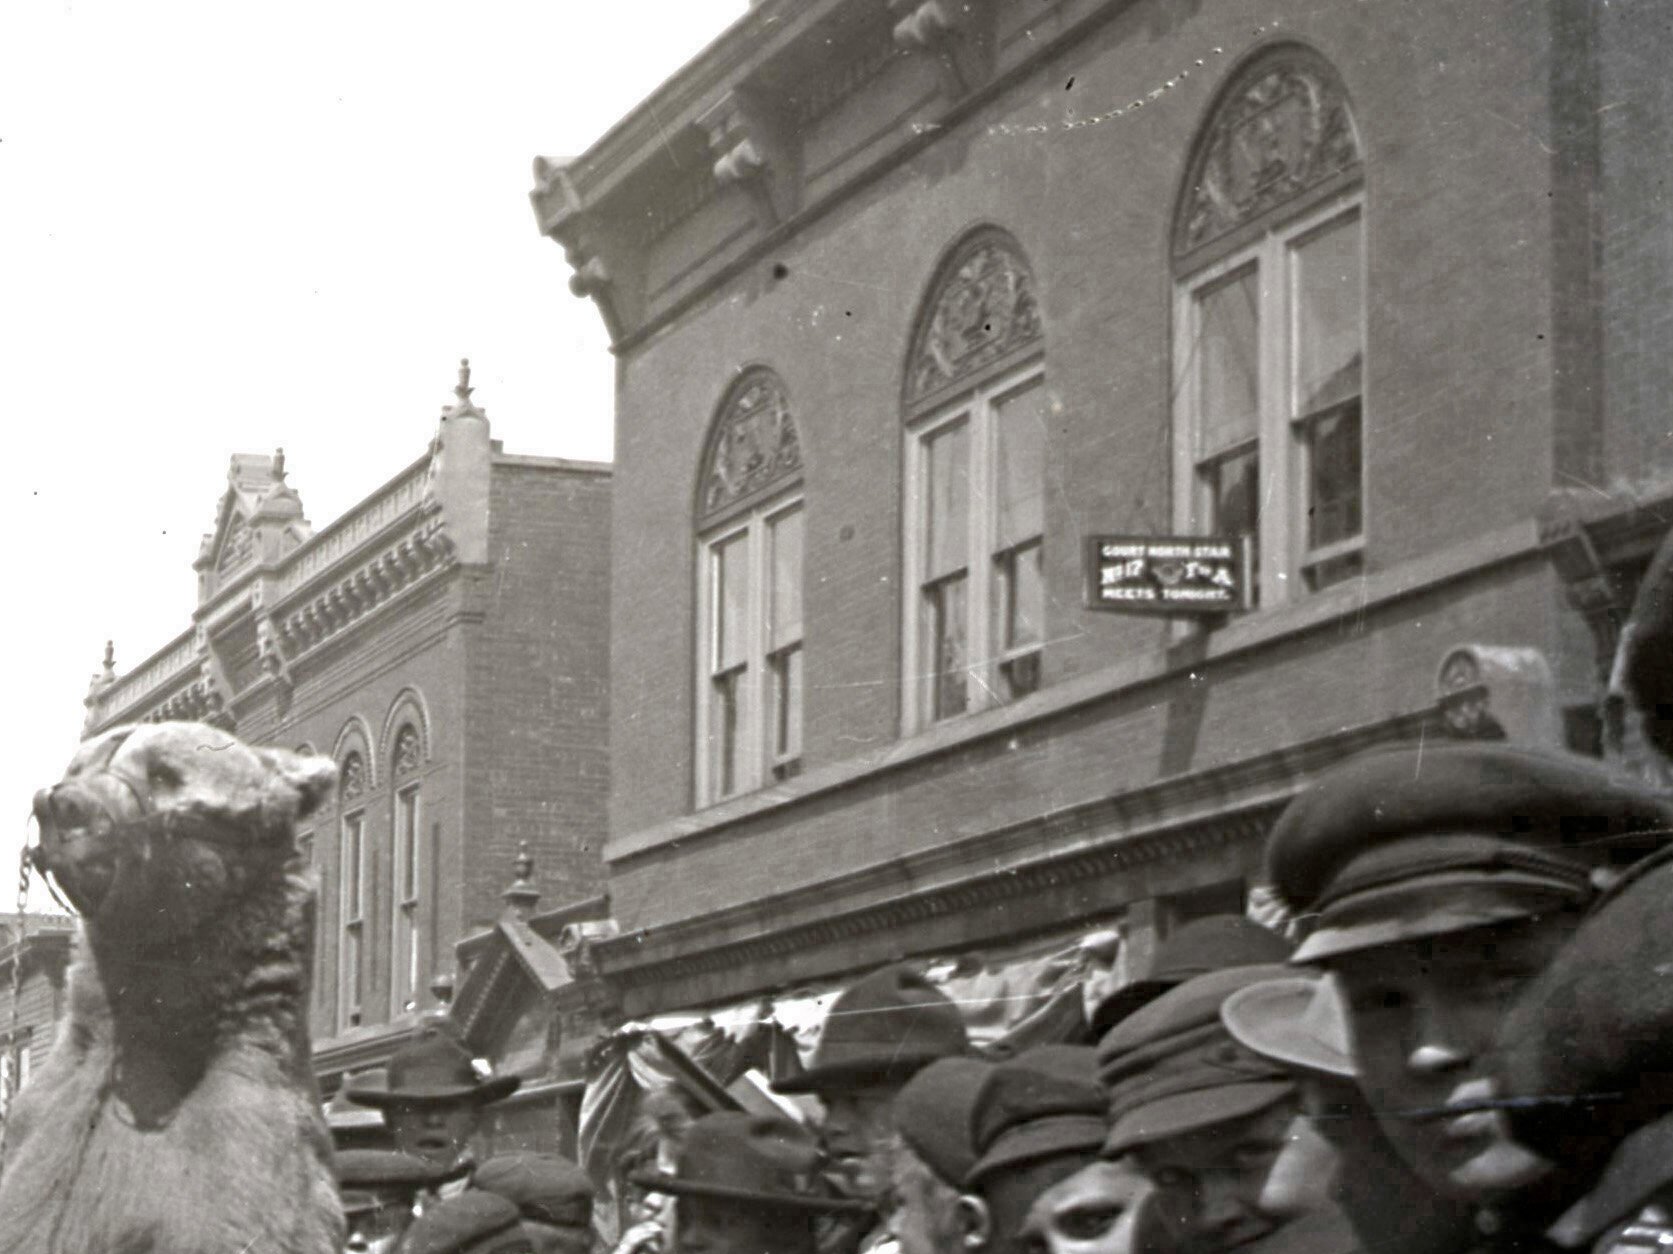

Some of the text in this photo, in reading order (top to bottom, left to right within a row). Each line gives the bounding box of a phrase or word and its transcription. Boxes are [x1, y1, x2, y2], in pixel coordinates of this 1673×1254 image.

[1102, 545, 1231, 558] COURT NORTH STAR
[1102, 587, 1155, 599] MEETS
